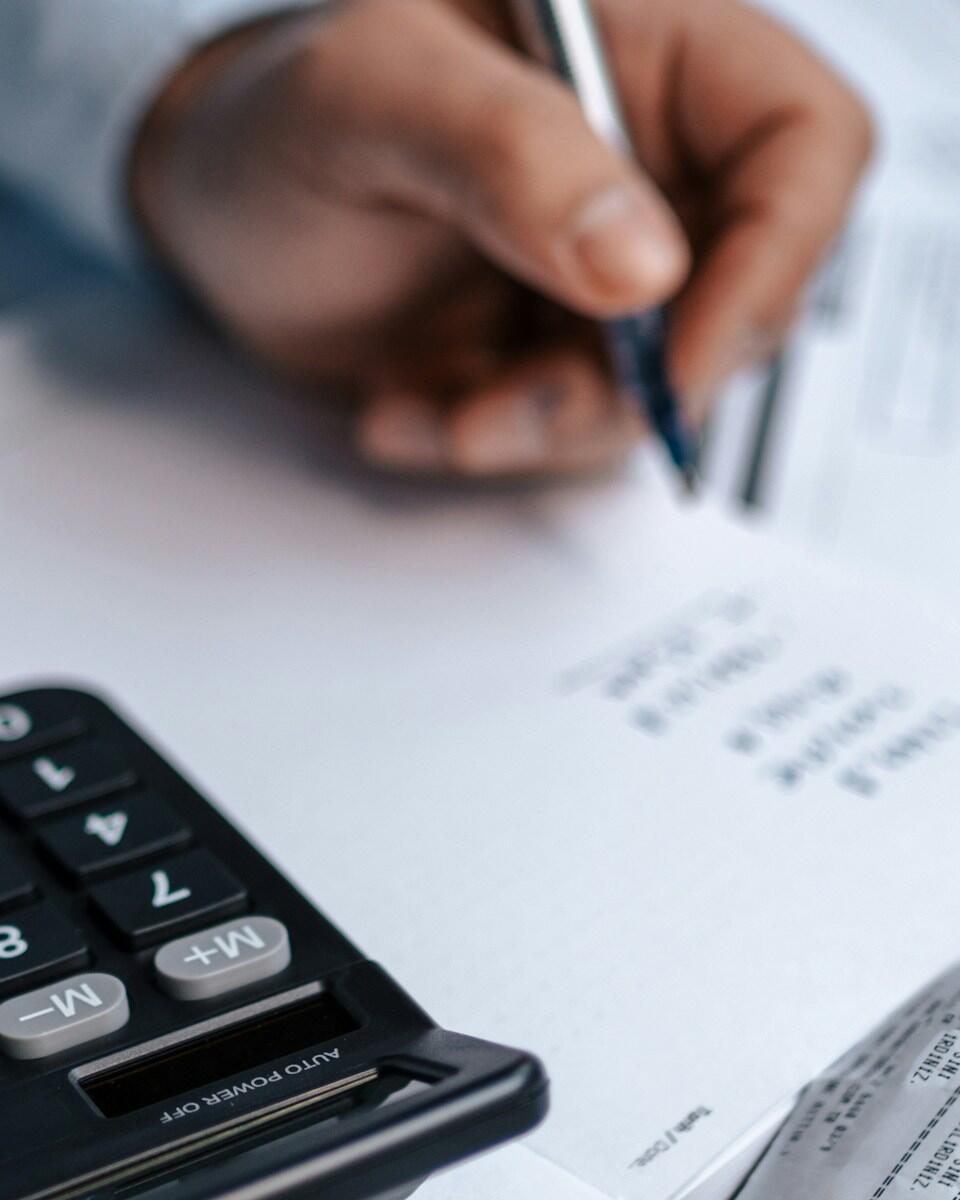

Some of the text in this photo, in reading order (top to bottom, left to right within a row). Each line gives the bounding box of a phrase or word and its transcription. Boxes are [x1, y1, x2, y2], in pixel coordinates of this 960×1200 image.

[35, 759, 74, 790] 1
[85, 812, 127, 845] 4
[152, 870, 191, 907] 7
[182, 925, 266, 966] M+
[18, 983, 103, 1024] M-
[159, 1047, 340, 1125] AUTO POWER OFF
